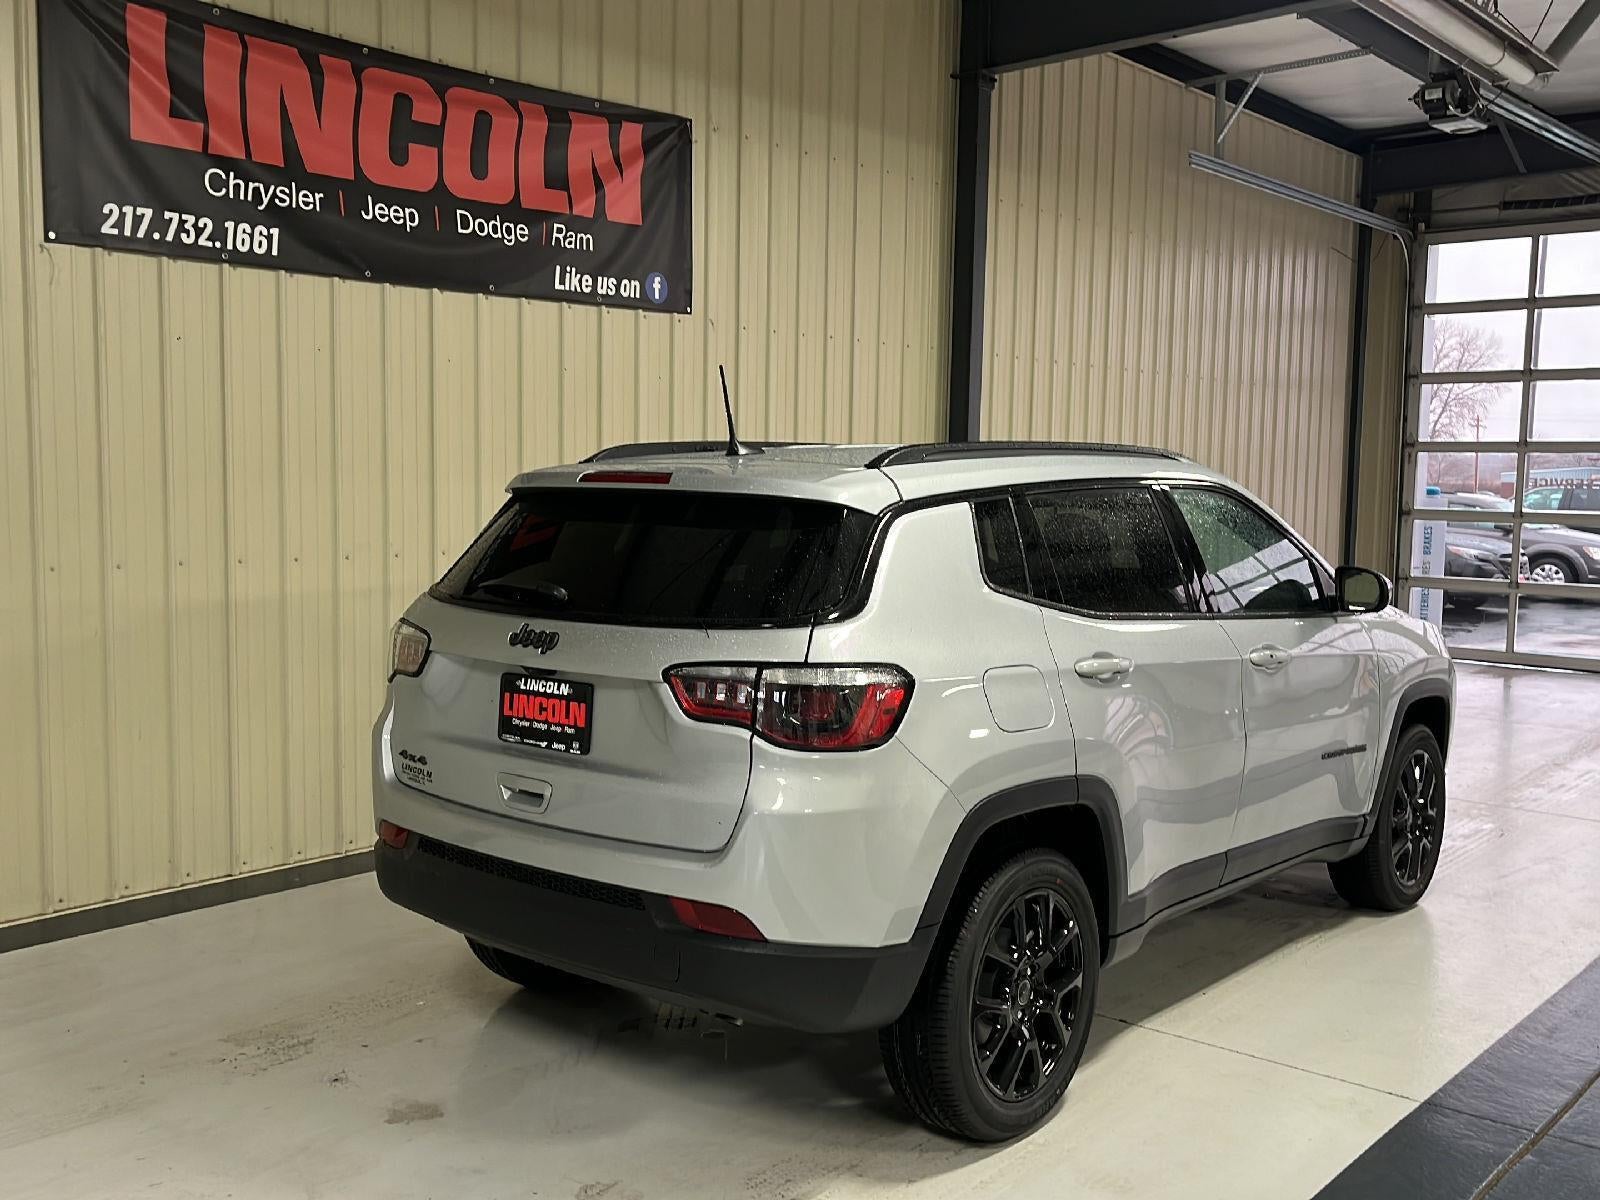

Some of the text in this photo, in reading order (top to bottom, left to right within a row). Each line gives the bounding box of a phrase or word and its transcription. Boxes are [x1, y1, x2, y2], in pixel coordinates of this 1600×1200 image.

[125, 3, 643, 225] LINCOLN
[204, 168, 594, 251] Chrysler Jeep Dodge Ram
[100, 203, 280, 256] 217.732.1661
[554, 265, 592, 293] Like
[597, 277, 617, 295] us
[620, 279, 640, 298] on
[1423, 526, 1432, 555] BRAKES
[1420, 587, 1429, 621] ATTERIES
[508, 622, 560, 654] Jeep
[520, 677, 569, 696] LINCOLN
[503, 692, 586, 728] LINCOLN
[512, 718, 530, 728] Chrysler
[532, 721, 548, 731] Dodge
[550, 723, 562, 733] Jeep
[551, 741, 566, 752] Jeep
[402, 763, 432, 778] LINCOLN
